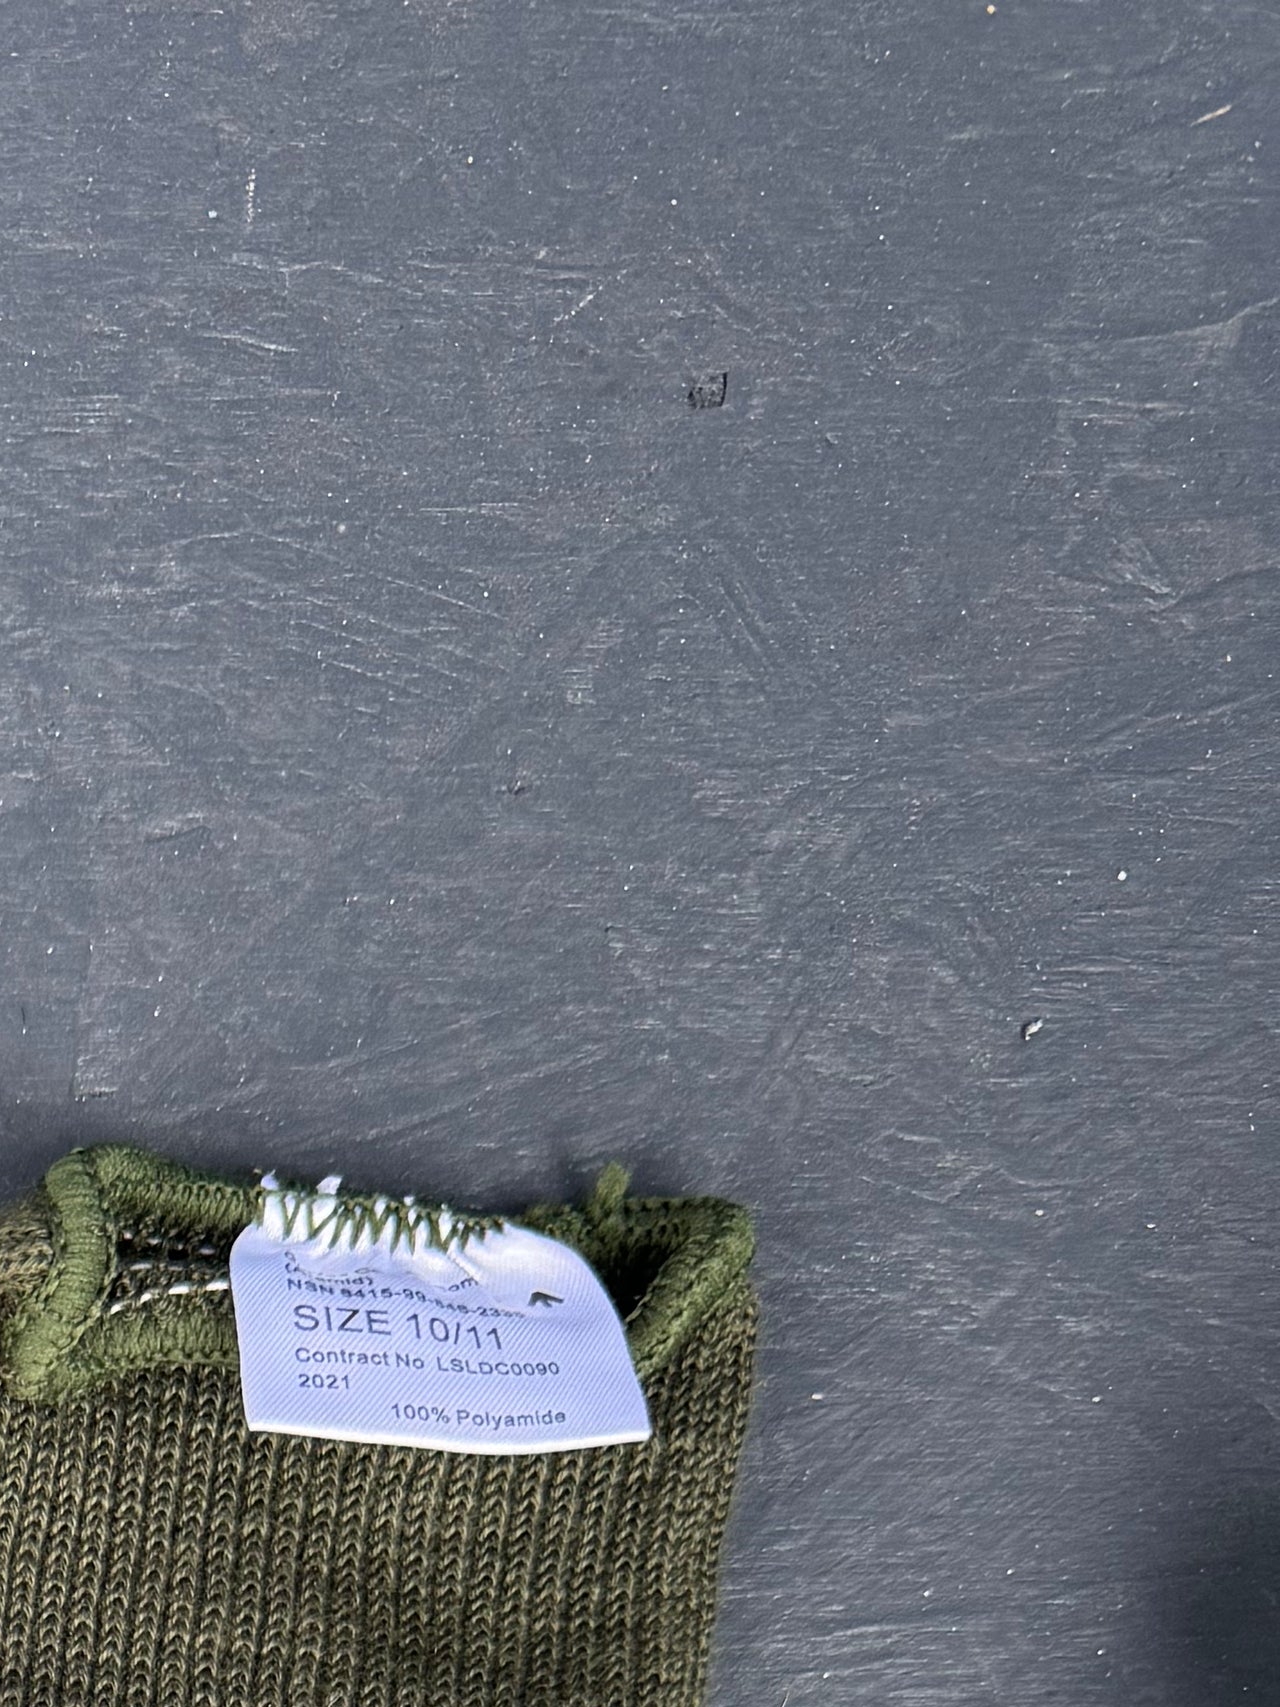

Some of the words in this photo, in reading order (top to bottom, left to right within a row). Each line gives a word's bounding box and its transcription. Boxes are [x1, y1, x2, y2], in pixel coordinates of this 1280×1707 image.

[293, 1304, 392, 1337] SIZE
[406, 1313, 503, 1350] 10/11
[295, 1347, 390, 1367] Contract
[395, 1353, 425, 1370] No
[437, 1357, 560, 1376] LSLDC0090
[298, 1374, 351, 1390] 2021
[391, 1403, 451, 1424] 100%
[456, 1409, 567, 1430] Polyamide
